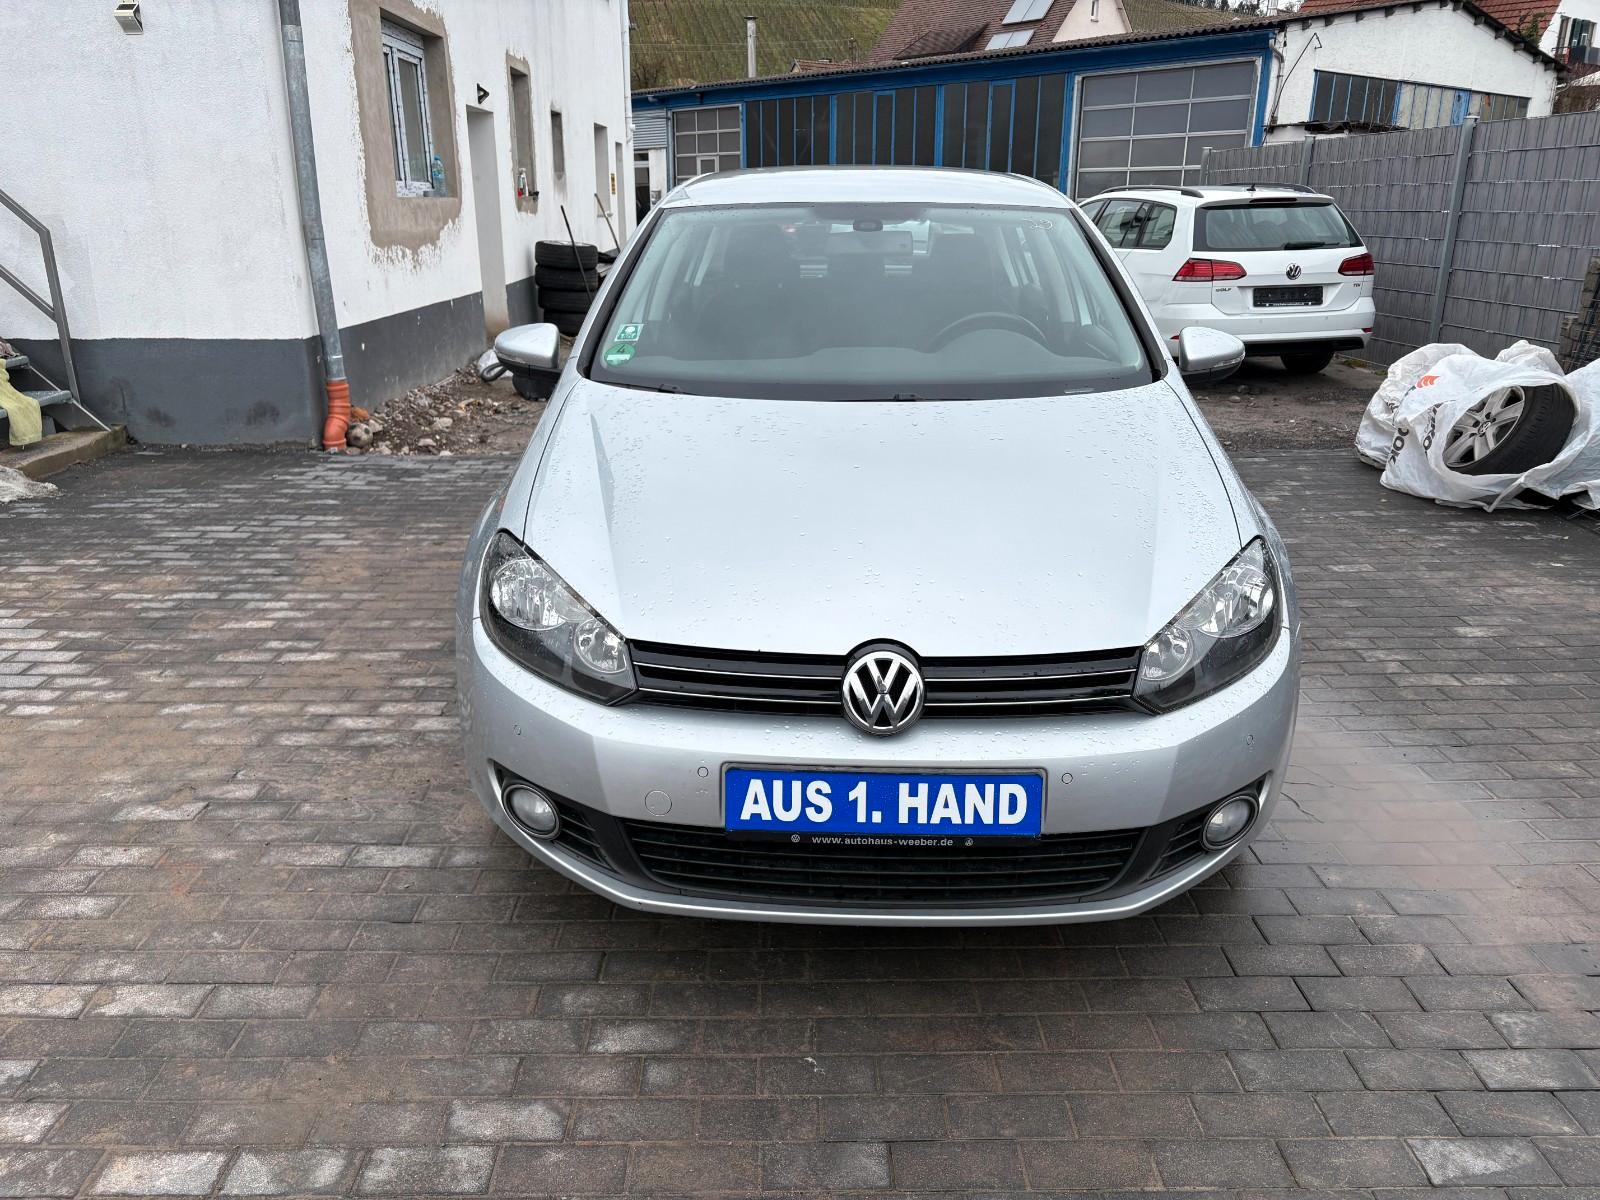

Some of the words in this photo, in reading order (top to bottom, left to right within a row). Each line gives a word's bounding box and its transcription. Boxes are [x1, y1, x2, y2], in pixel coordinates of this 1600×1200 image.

[740, 778, 833, 823] AUS
[848, 781, 882, 824] 1.
[898, 782, 1028, 825] HAND
[811, 835, 954, 847] www.autohaus-weeber.de
